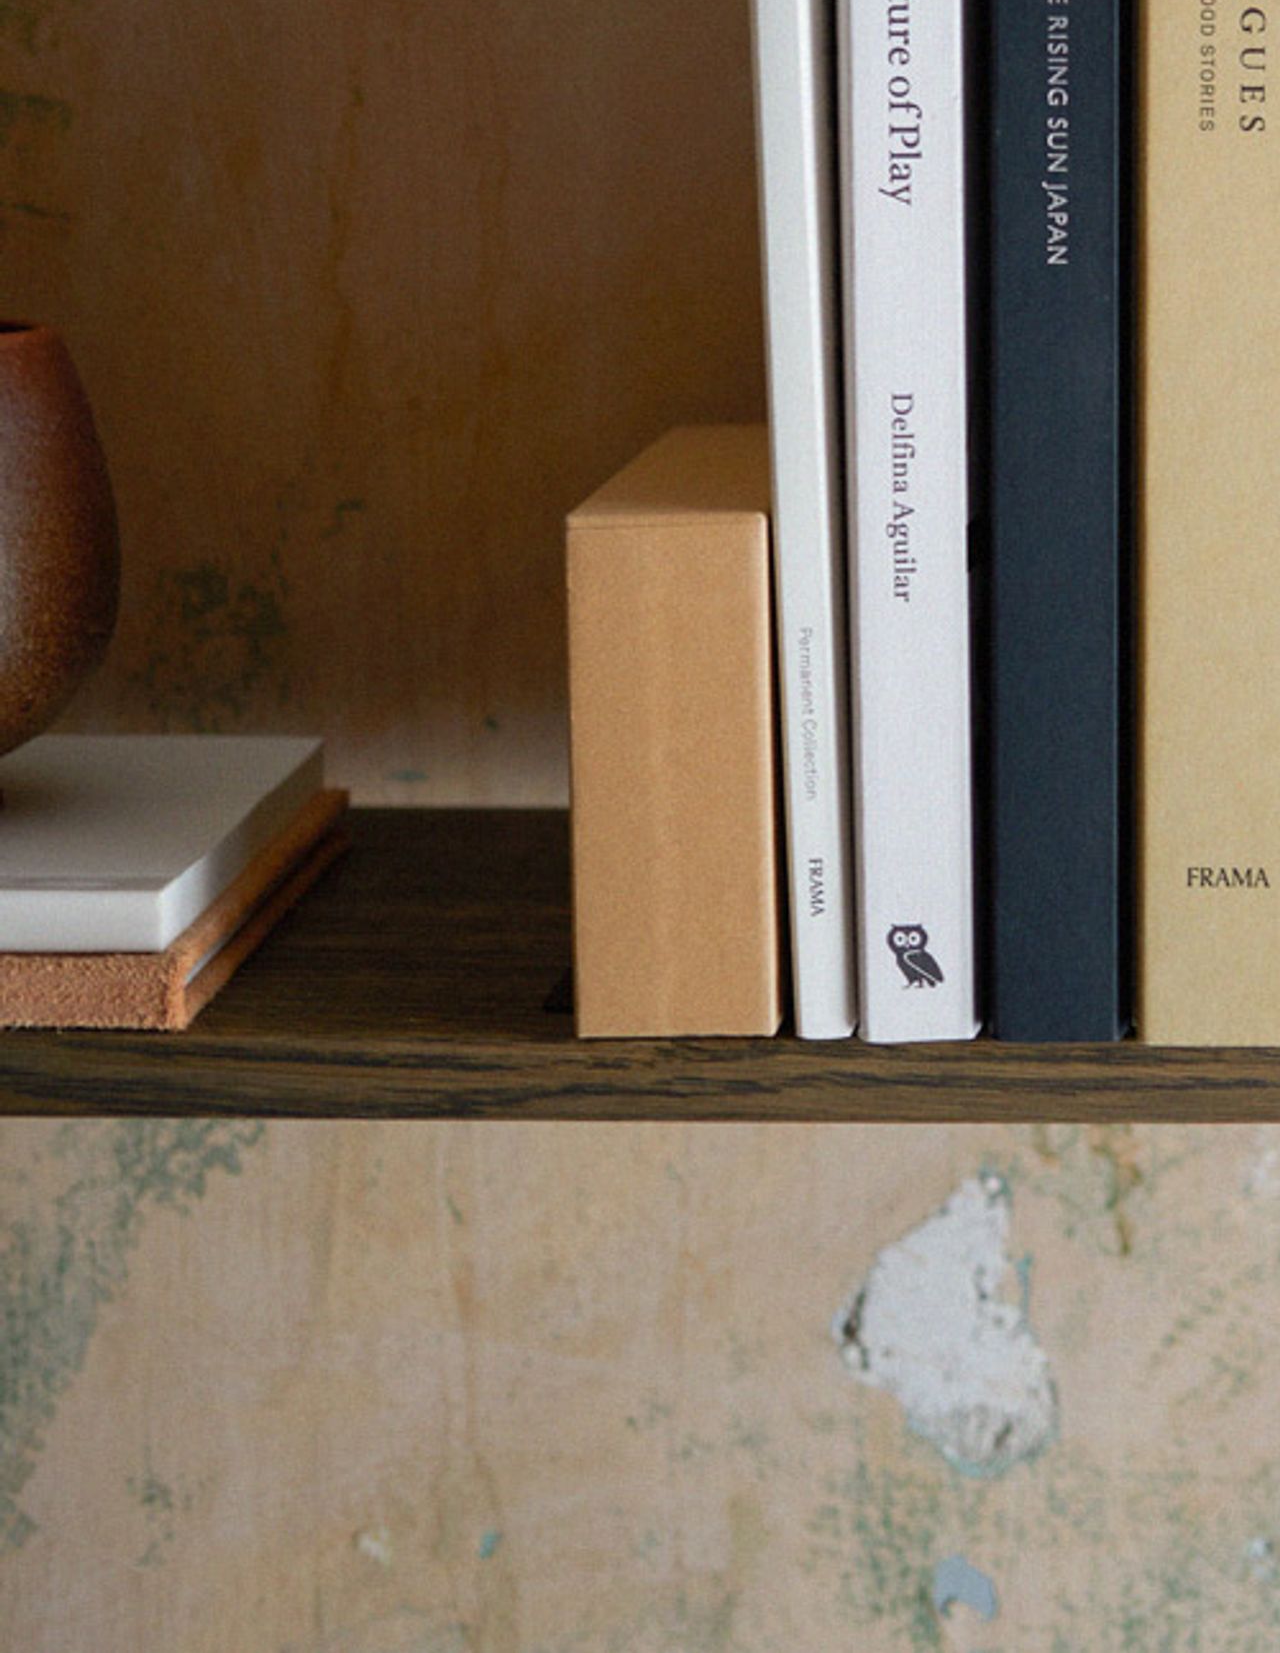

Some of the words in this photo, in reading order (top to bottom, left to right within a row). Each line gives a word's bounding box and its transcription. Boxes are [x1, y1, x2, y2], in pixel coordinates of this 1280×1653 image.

[888, 75, 923, 120] of
[1046, 15, 1069, 106] RISING
[1198, 44, 1217, 132] STORIES
[878, 123, 923, 206] Play
[1046, 117, 1069, 173] SUN
[1041, 180, 1069, 265] JAPAN
[891, 393, 916, 494] Delfina
[886, 500, 918, 603] Aguilar
[797, 627, 815, 715] Permanent
[800, 718, 818, 801] Collection
[808, 858, 825, 917] FRAMA
[1186, 866, 1271, 889] FRAMA
